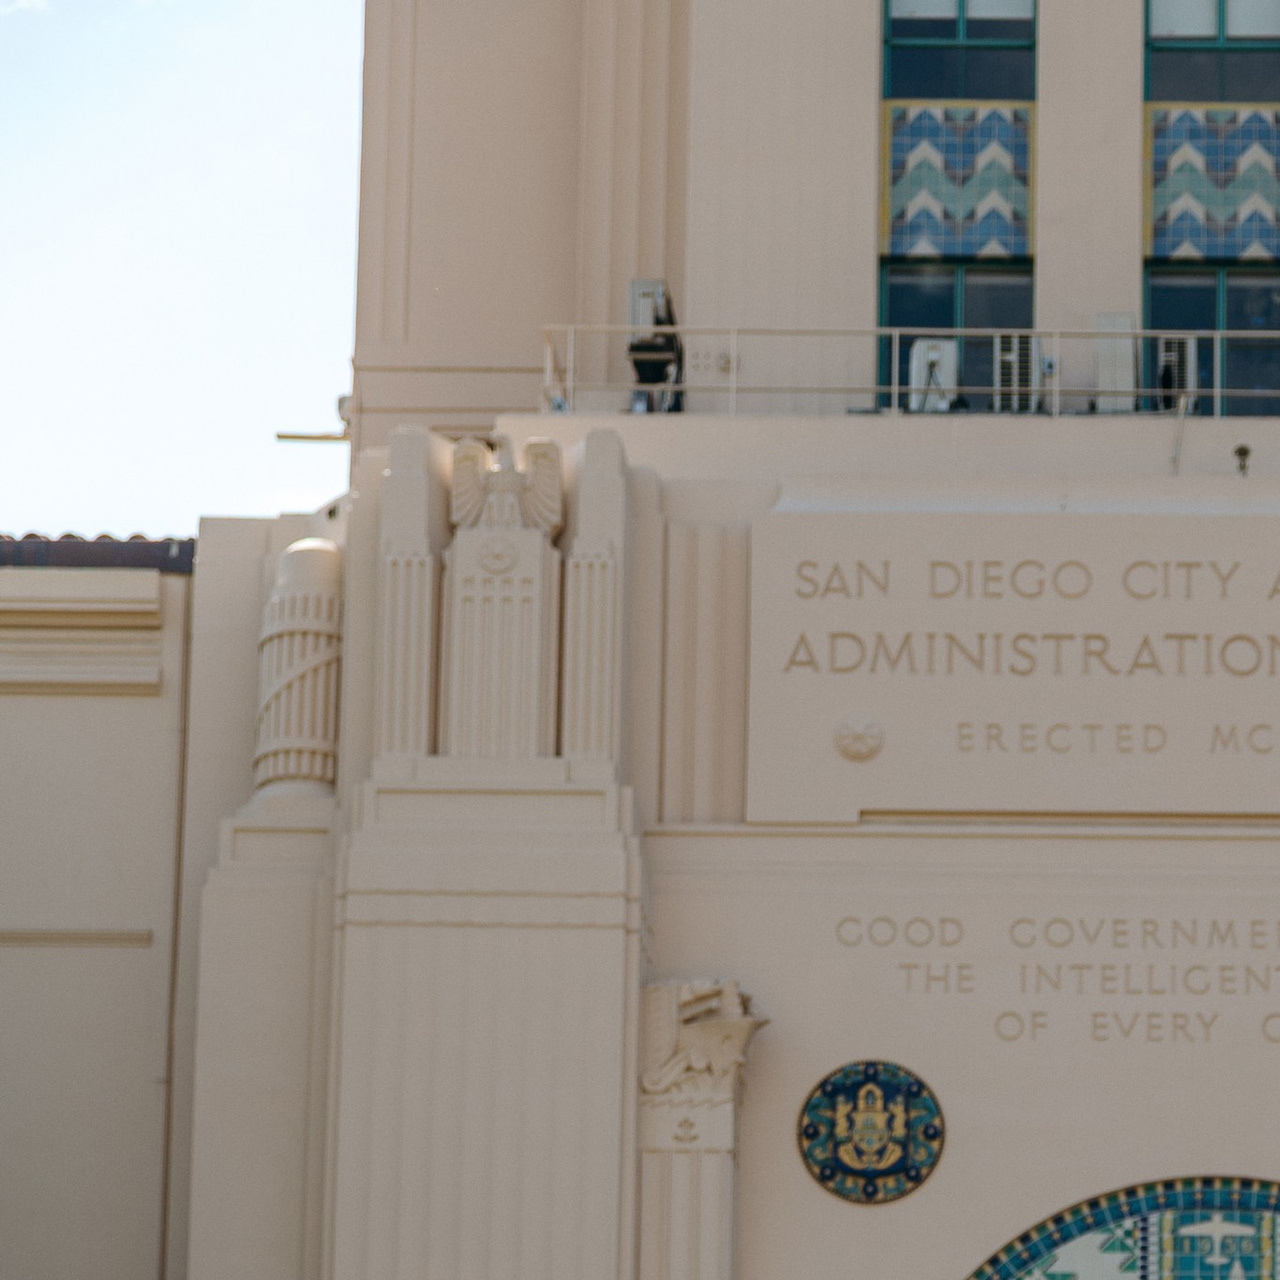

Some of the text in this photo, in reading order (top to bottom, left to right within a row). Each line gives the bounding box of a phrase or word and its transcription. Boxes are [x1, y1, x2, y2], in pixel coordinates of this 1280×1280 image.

[794, 559, 891, 600] SAN
[929, 559, 1093, 600] DIEGO
[1121, 560, 1240, 601] CITY
[957, 722, 1168, 755] ERECTED
[836, 916, 964, 948] GOOD
[900, 963, 975, 994] THE
[994, 1010, 1048, 1042] OF
[1091, 1011, 1219, 1043] EVERY
